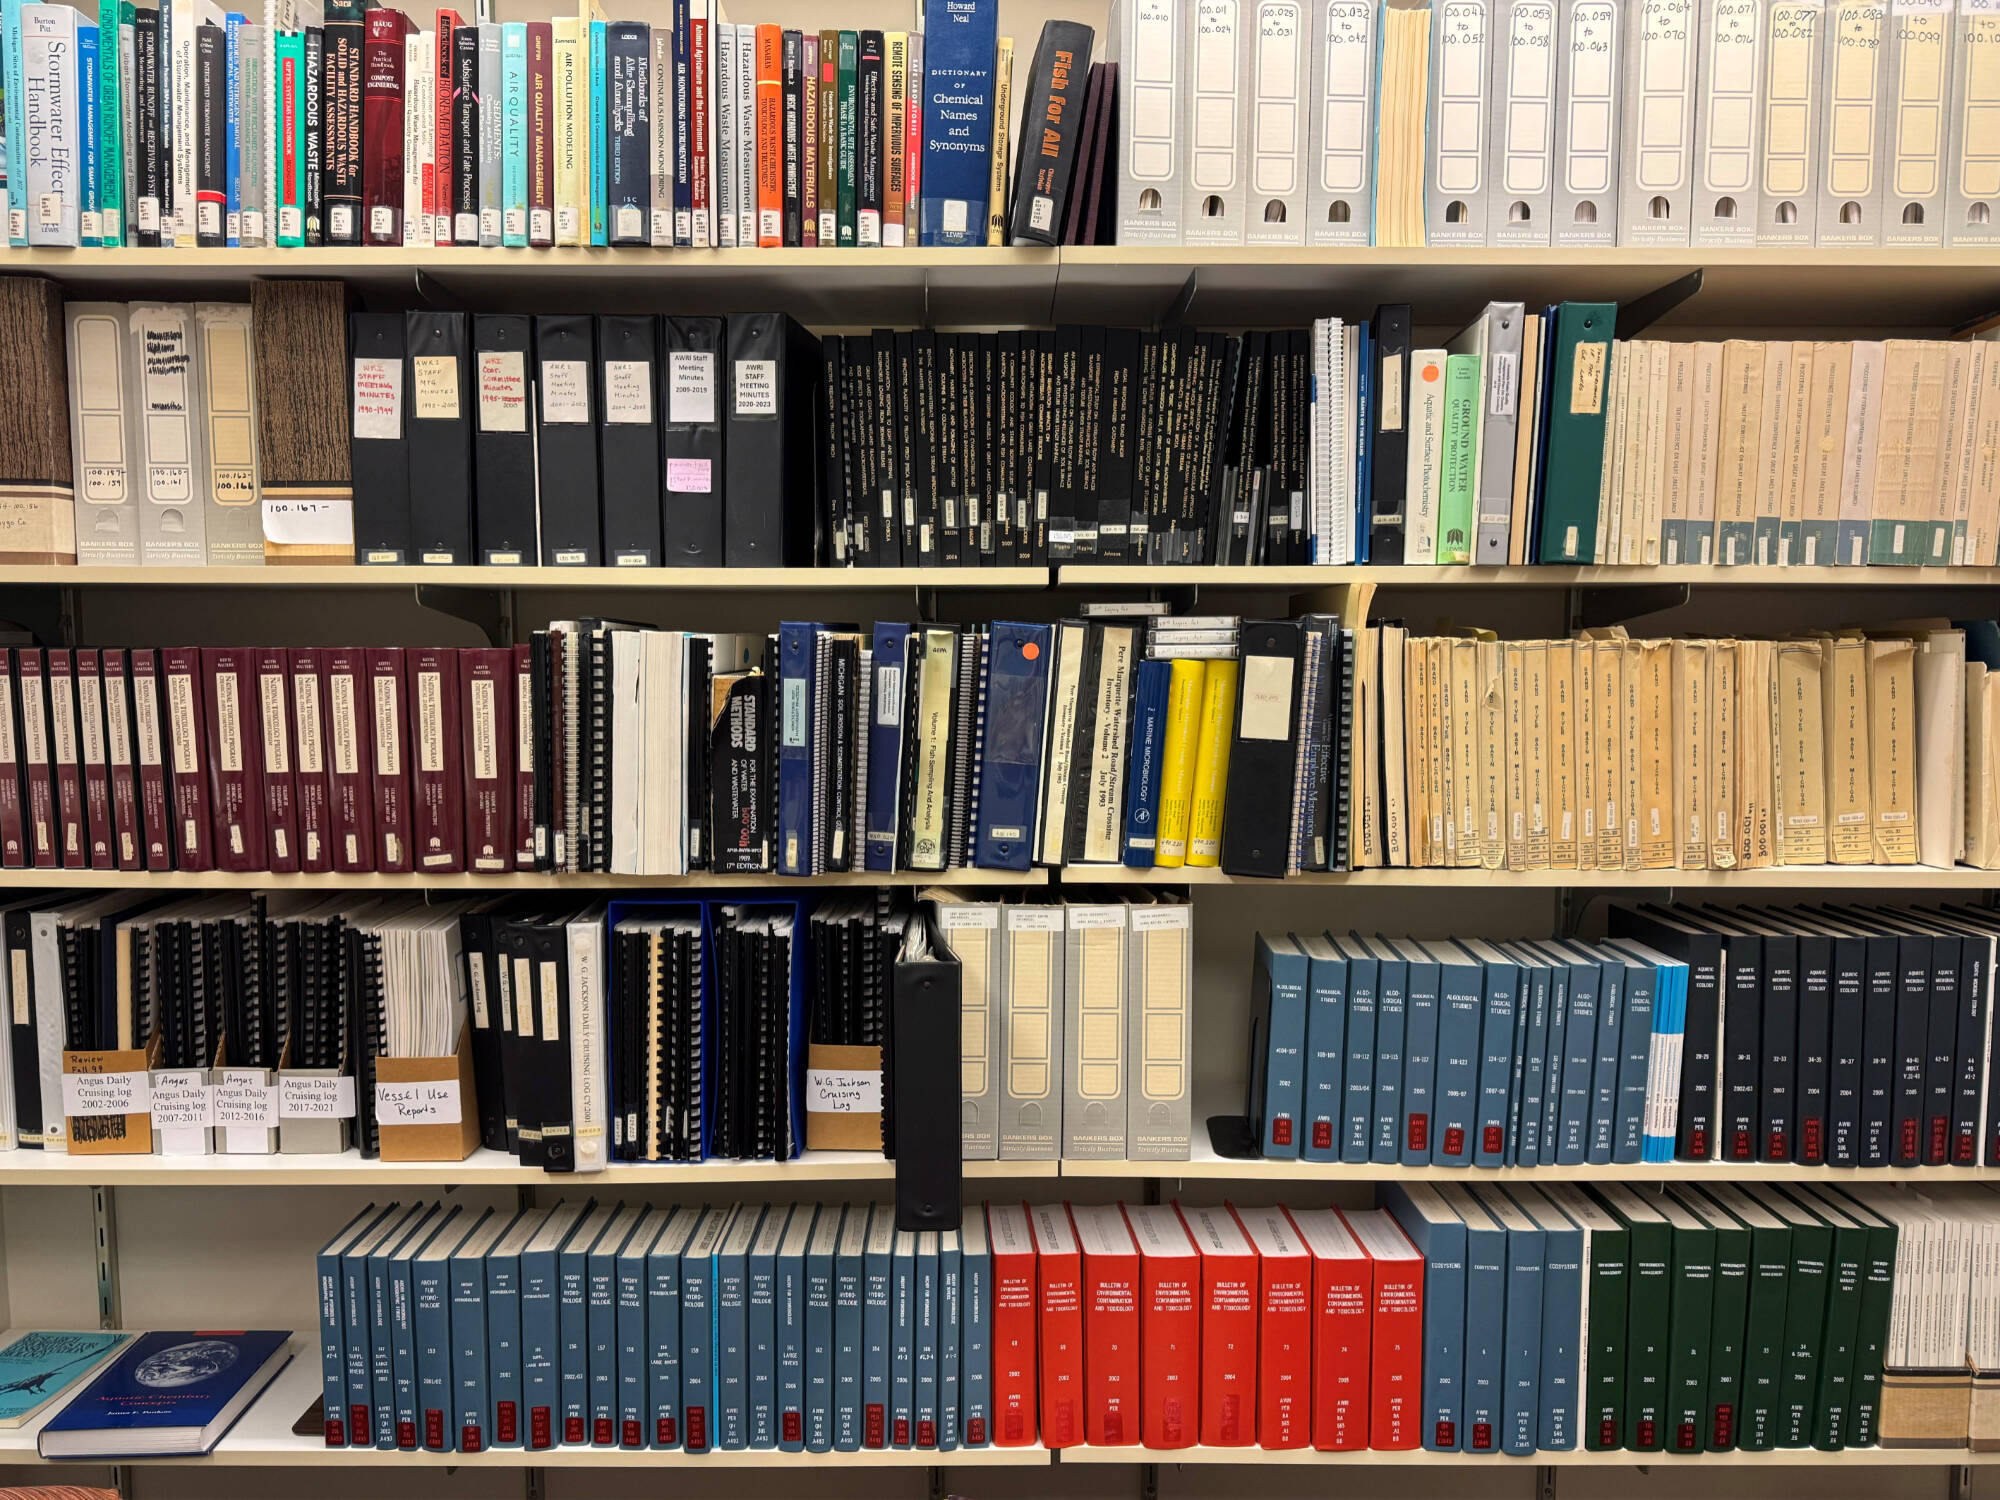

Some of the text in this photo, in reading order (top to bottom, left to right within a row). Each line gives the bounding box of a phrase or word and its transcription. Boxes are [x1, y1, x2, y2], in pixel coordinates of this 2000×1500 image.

[947, 2, 976, 10] Howard
[953, 14, 969, 23] Neal
[1140, 12, 1169, 23] 100.010
[1262, 8, 1295, 19] 100.025
[34, 17, 56, 25] Burton
[40, 25, 51, 33] Pitt
[1198, 25, 1231, 35] 100.024
[1261, 28, 1293, 38] 100.031
[1772, 27, 1814, 39] 100.082
[1326, 32, 1367, 44] 100.042
[1442, 33, 1485, 45] 100.052
[1641, 30, 1686, 42] 100.070
[1896, 30, 1941, 45] 100.099
[439, 18, 450, 174] Handbook of BIOREMEDIATION
[565, 70, 573, 120] POLLUTION
[933, 94, 983, 105] Chemical
[102, 9, 114, 198] FUNDAMENTALS OF URBAN RUNOFF MANAGEMENT
[1042, 50, 1073, 157] Fish for All
[307, 51, 318, 171] HAZARDOUS WASTE
[326, 53, 335, 171] FACILITY ASSESSMENTS
[336, 38, 347, 186] SOLID and HAZARDOUS WASTE
[349, 48, 360, 177] STANDARD HANDBOOK for
[509, 72, 520, 157] AIR QUALITY
[535, 90, 544, 135] QUALITY
[890, 41, 903, 192] REMOTE SENSING OF IMPERVIOUS SURFACES
[940, 110, 977, 120] Names
[28, 77, 47, 167] Handbook
[48, 41, 69, 202] Stormwater Effect
[462, 59, 472, 210] Subsurface Transport and Fate Processes
[948, 126, 969, 136] and
[806, 76, 816, 208] HAZARDOUS MATERIALS
[929, 140, 985, 152] Synonyms
[535, 135, 544, 204] MANAGEMENT
[679, 364, 704, 372] Meeting
[359, 391, 395, 400] MINUTES
[1449, 399, 1459, 492] QUALITY PROTECTION
[1459, 400, 1470, 492] GROUND WATER
[1419, 394, 1434, 518] Aquatic and Surface Photochemistry
[270, 504, 316, 514] 100.167
[1115, 666, 1124, 706] Marquette
[1104, 678, 1114, 715] Inventory
[731, 696, 742, 749] METHODS
[744, 695, 756, 752] STANDARD
[1112, 707, 1121, 750] Watershed
[1102, 723, 1111, 752] Volume
[1140, 716, 1154, 802] MARINE MICROBIOLOGY
[926, 760, 935, 790] Sampling
[1099, 771, 1107, 787] July
[1108, 752, 1118, 804] Road/Stream
[926, 791, 934, 804] And
[925, 805, 933, 830] Analysis
[70, 1055, 104, 1064] Review
[77, 1075, 132, 1086] Angus Daily
[161, 1075, 188, 1086] Angus
[284, 1079, 338, 1090] Angus Daily
[835, 1077, 871, 1088] Jackson
[77, 1086, 132, 1098] Cruising log
[152, 1088, 206, 1100] Angus Daily
[284, 1091, 338, 1102] Cruising log
[378, 1089, 449, 1102] Vessel Use
[819, 1089, 862, 1100] Cruising
[82, 1099, 129, 1108] 2002-2006
[153, 1101, 207, 1112] Cruising log
[289, 1103, 334, 1112] 2017-2021
[832, 1100, 851, 1111] Log
[394, 1103, 436, 1119] Reports
[157, 1113, 202, 1123] 2007-2011
